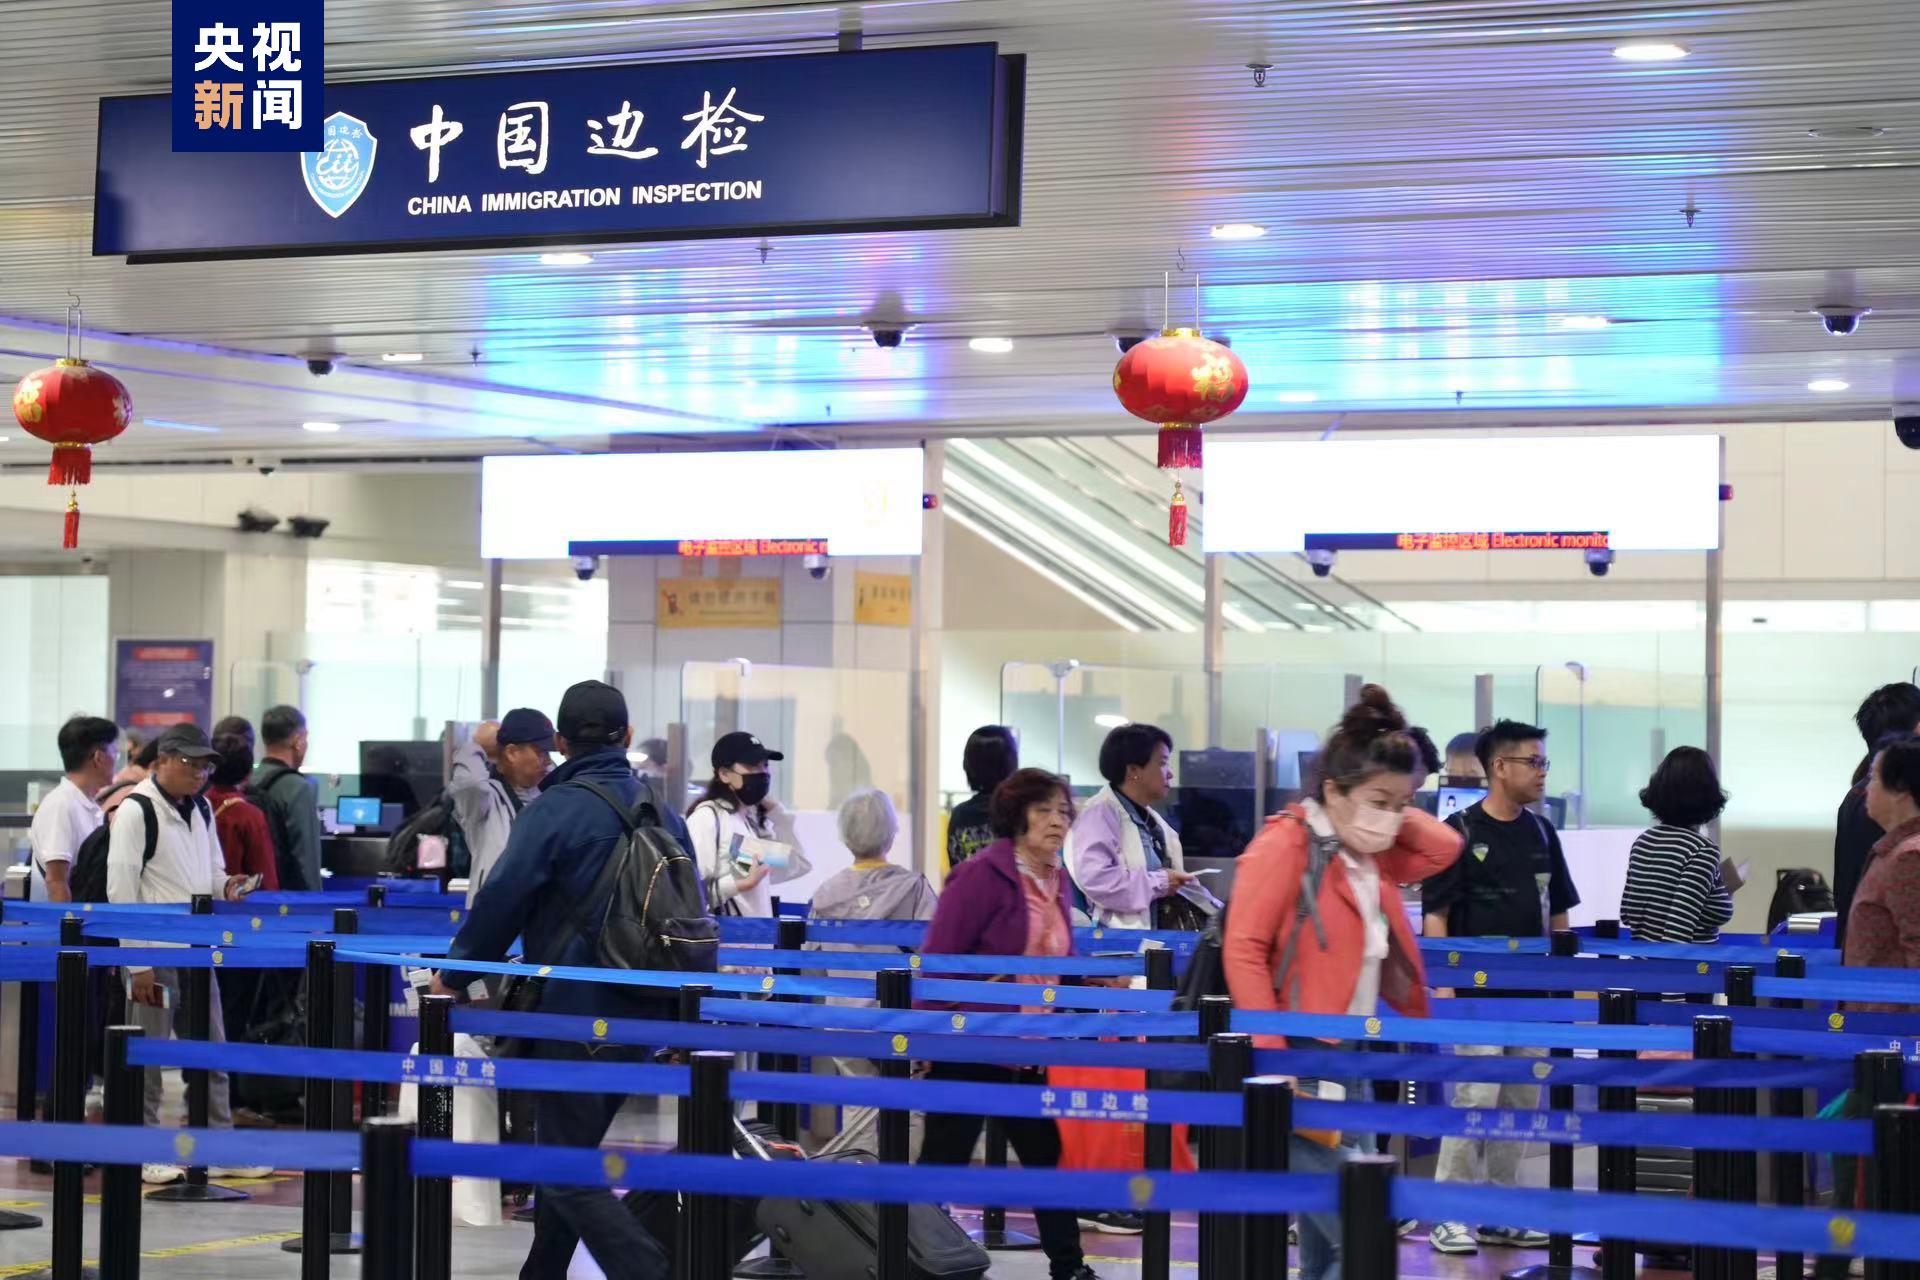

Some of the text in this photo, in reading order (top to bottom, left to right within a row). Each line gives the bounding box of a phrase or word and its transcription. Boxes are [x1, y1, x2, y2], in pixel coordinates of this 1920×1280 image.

[410, 87, 765, 183] 中国边检
[408, 180, 762, 215] CHINA IMMIGRATION INSPECTION
[1491, 532, 1559, 548] Electronic
[402, 1058, 496, 1078] 中国边检
[1041, 1089, 1149, 1112] 中国边检
